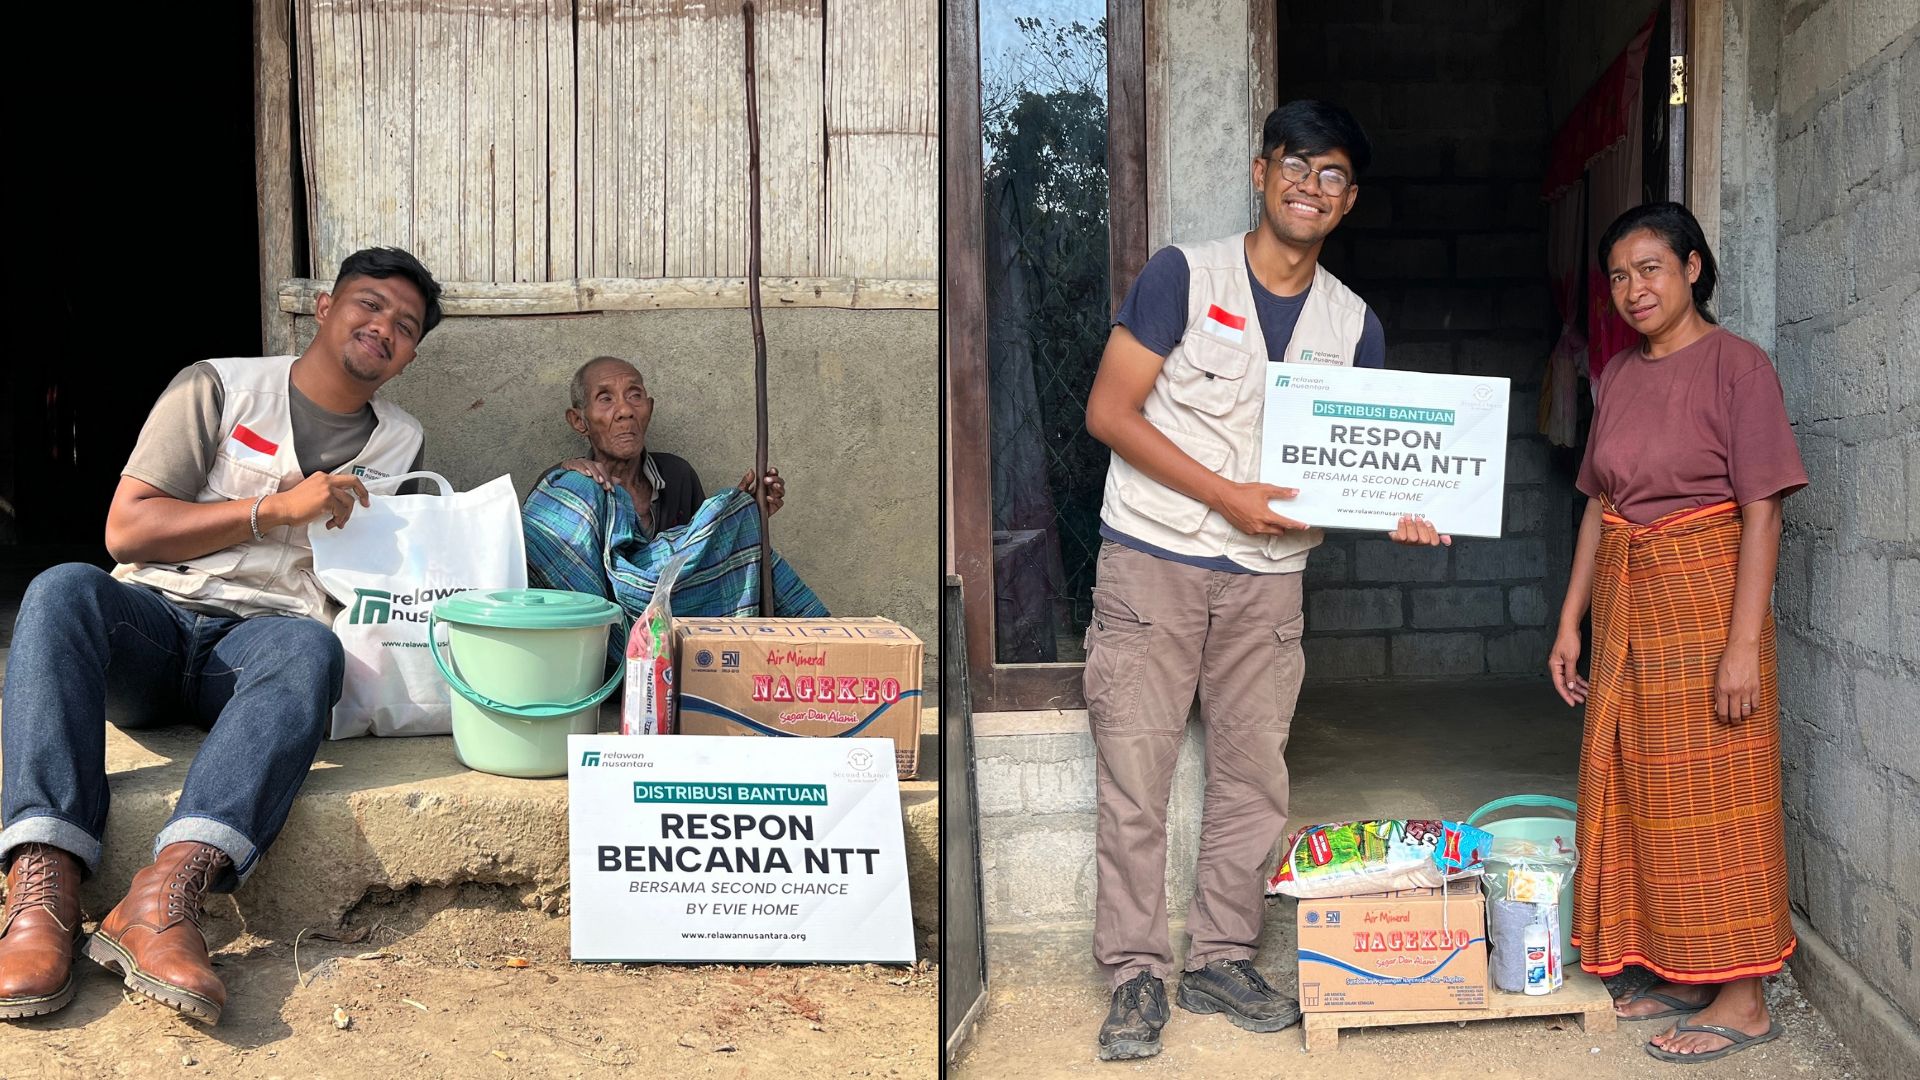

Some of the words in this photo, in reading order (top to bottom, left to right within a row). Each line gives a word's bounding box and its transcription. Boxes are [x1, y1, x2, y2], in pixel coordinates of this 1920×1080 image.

[1290, 383, 1330, 391] nusantara
[1292, 376, 1324, 384] relawan
[1314, 403, 1386, 418] DISTRIBUSI
[1390, 409, 1454, 423] BANTUAN
[1330, 424, 1442, 450] RESPON
[1282, 444, 1422, 472] BENCANA
[1431, 455, 1487, 476] NTT
[1302, 471, 1358, 483] BERSAMA
[1362, 474, 1409, 486] SECOND
[1412, 477, 1461, 490] CHANCE
[1342, 488, 1359, 498] BY
[1361, 489, 1386, 500] EVIE
[1389, 491, 1424, 502] HOME
[392, 588, 479, 606] relaw
[766, 650, 784, 665] Air
[786, 650, 827, 667] Mineral
[752, 674, 900, 704] NAGEKEO
[779, 711, 807, 725] Segar
[808, 708, 826, 720] Dan
[828, 710, 859, 723] Alami
[602, 760, 654, 768] nusantara
[604, 752, 644, 760] relawan
[636, 785, 733, 800] DISTRIBUSI
[738, 787, 826, 802] BANTUAN
[660, 813, 814, 840] RESPON
[598, 845, 793, 874] BENCANA
[805, 848, 880, 874] NTT
[629, 882, 706, 894] BERSAMA
[711, 882, 777, 895] SECOND
[781, 882, 849, 896] CHANCE
[686, 903, 708, 916] BY
[712, 903, 747, 916] EVIE
[752, 904, 800, 916] HOME
[1364, 911, 1378, 923] Air
[1380, 910, 1410, 923] Mineral
[681, 931, 807, 941] www.relawannusantara.org
[1352, 928, 1470, 952] NAGEKEO
[1398, 956, 1413, 964] Dan
